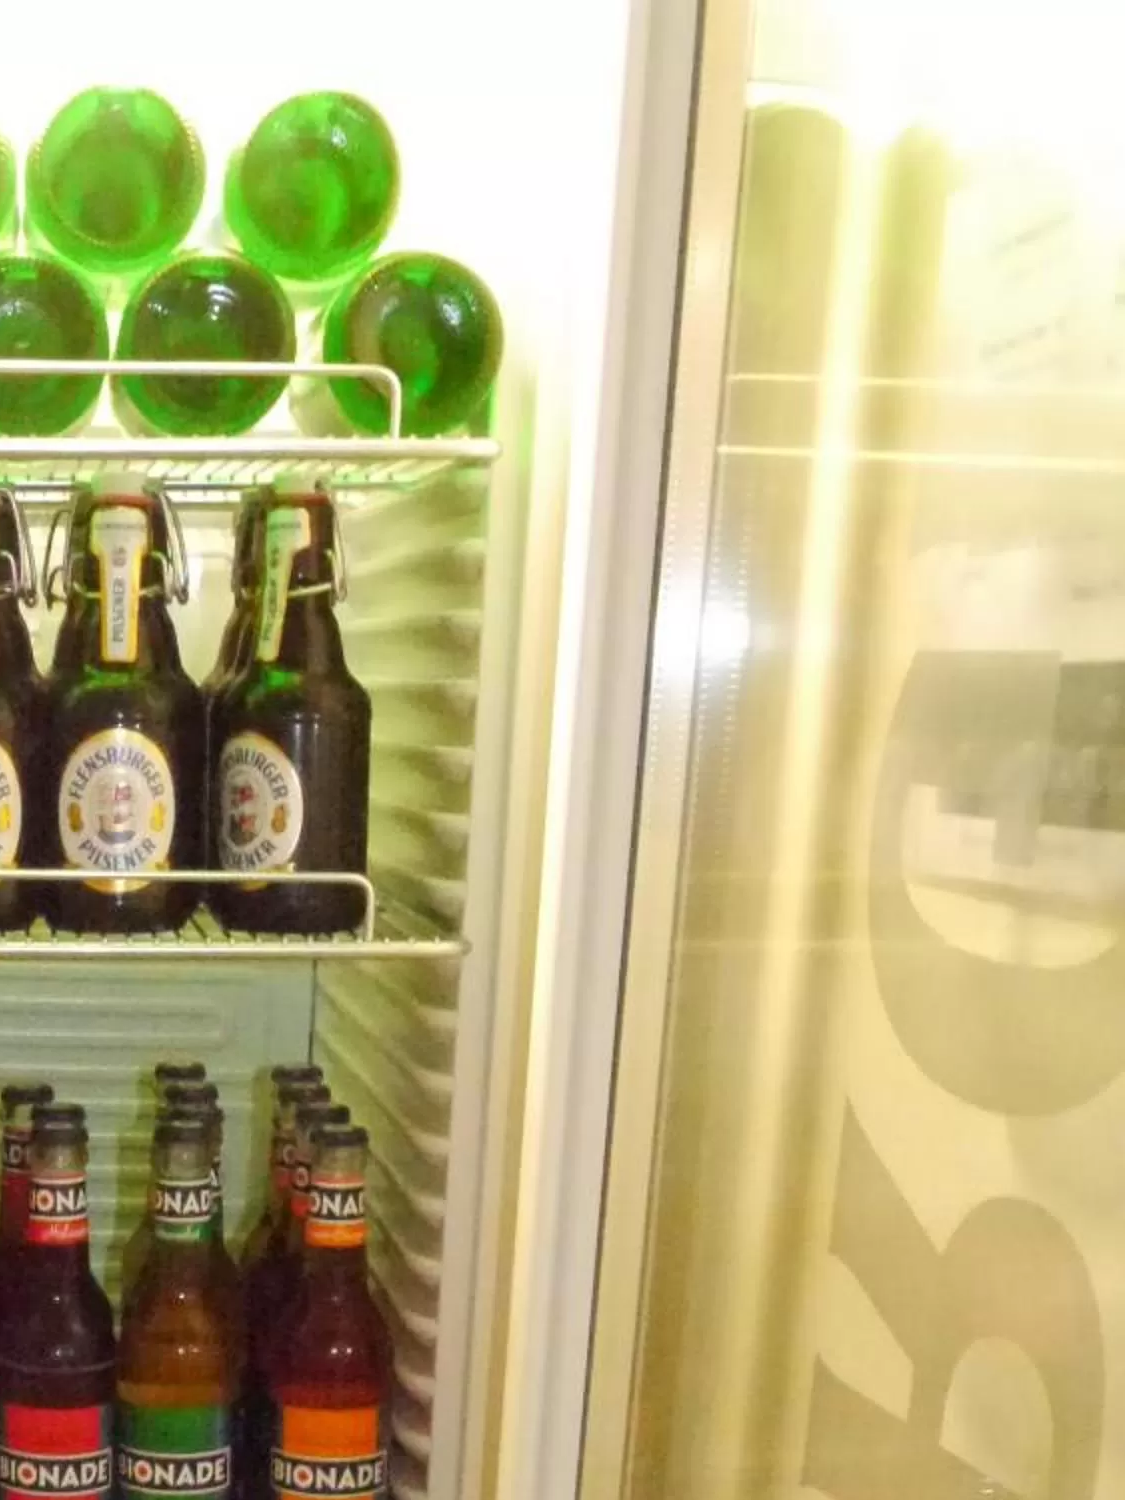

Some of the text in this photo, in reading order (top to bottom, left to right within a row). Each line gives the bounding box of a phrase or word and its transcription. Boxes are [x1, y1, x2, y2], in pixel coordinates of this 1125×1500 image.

[69, 745, 166, 801] FLENSBURGER
[77, 837, 157, 869] PILSENER
[0, 1456, 108, 1488] BIONADE
[120, 1455, 226, 1488] BIONADE
[275, 1458, 382, 1490] BIONADE
